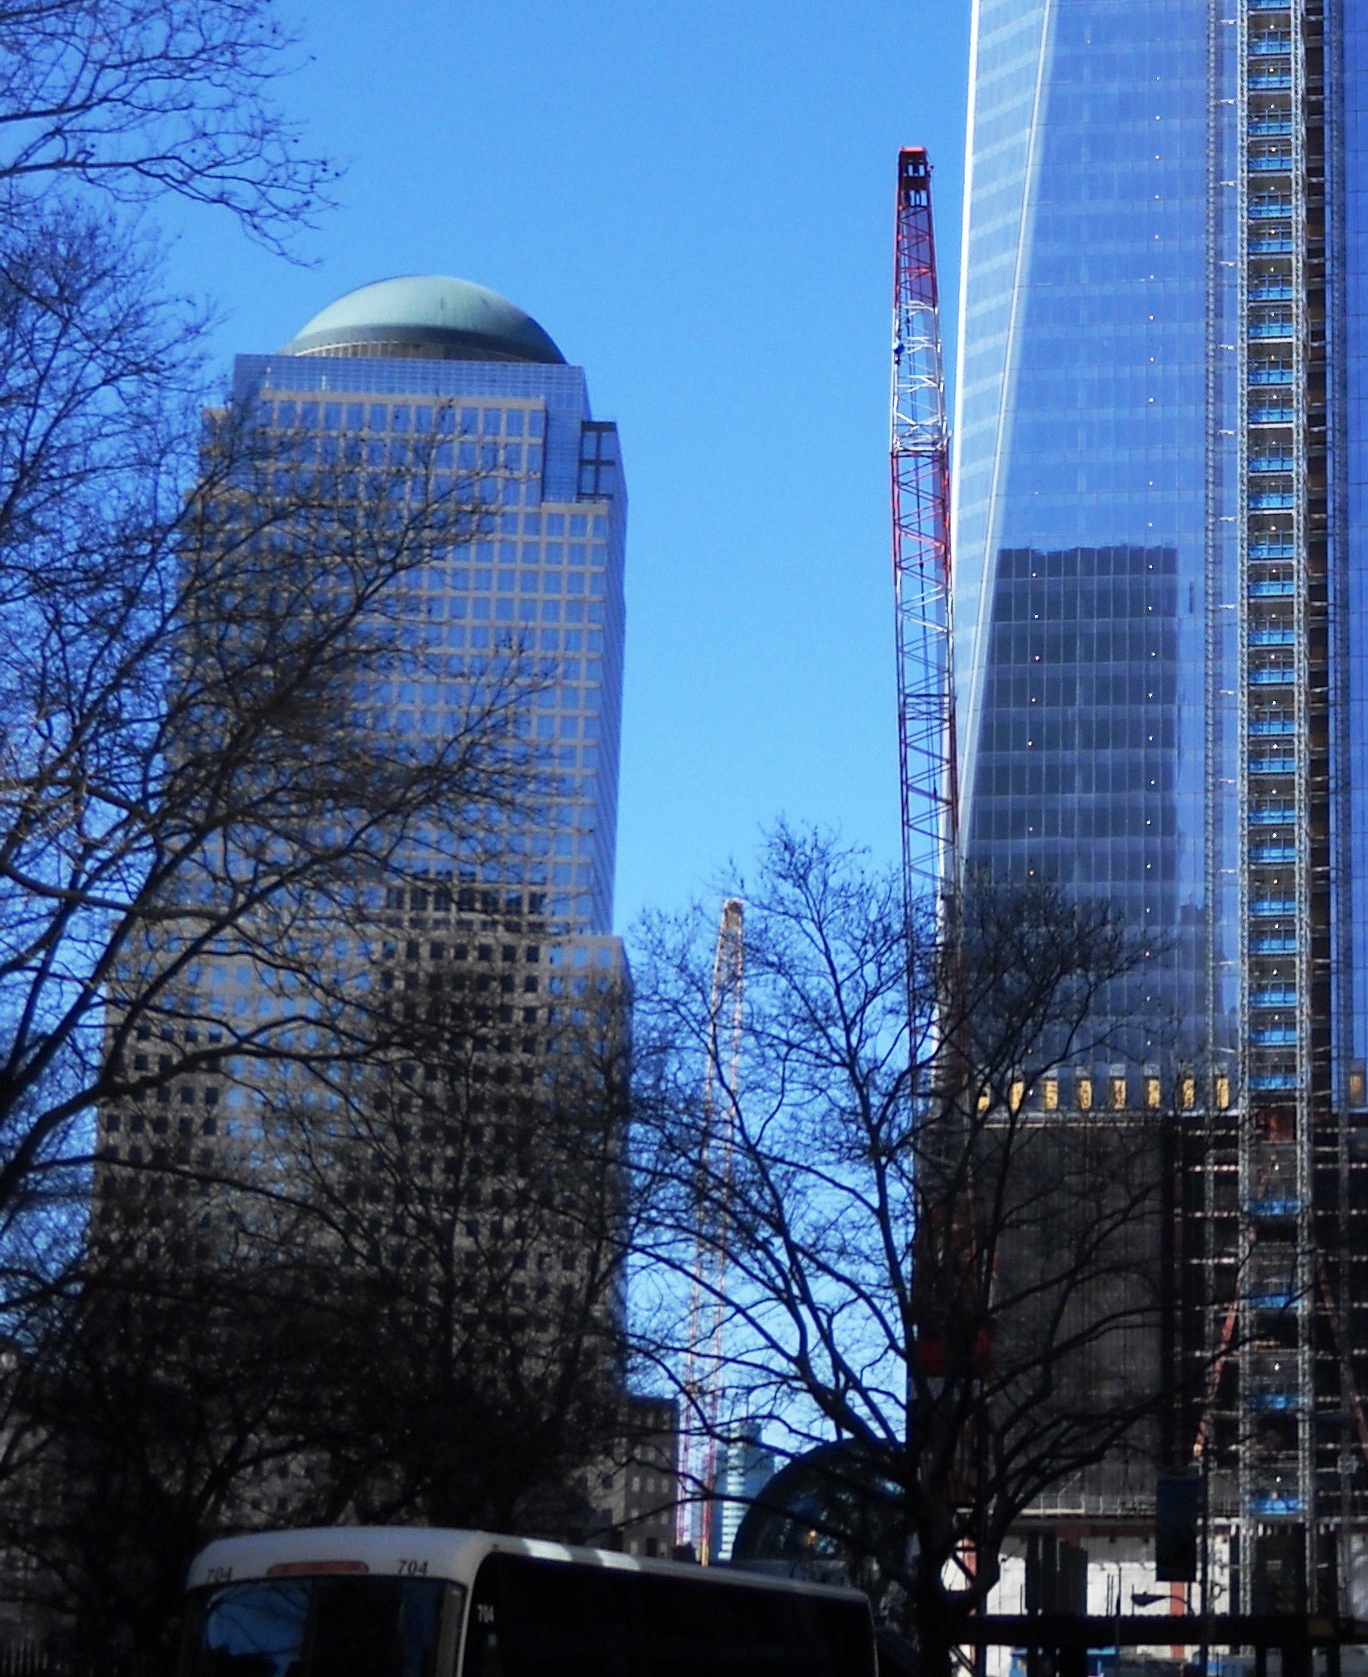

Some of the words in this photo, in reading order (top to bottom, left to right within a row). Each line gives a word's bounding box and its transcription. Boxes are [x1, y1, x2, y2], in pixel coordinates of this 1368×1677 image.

[206, 1566, 233, 1582] 704
[398, 1560, 428, 1575] 704
[477, 1604, 494, 1622] 704
